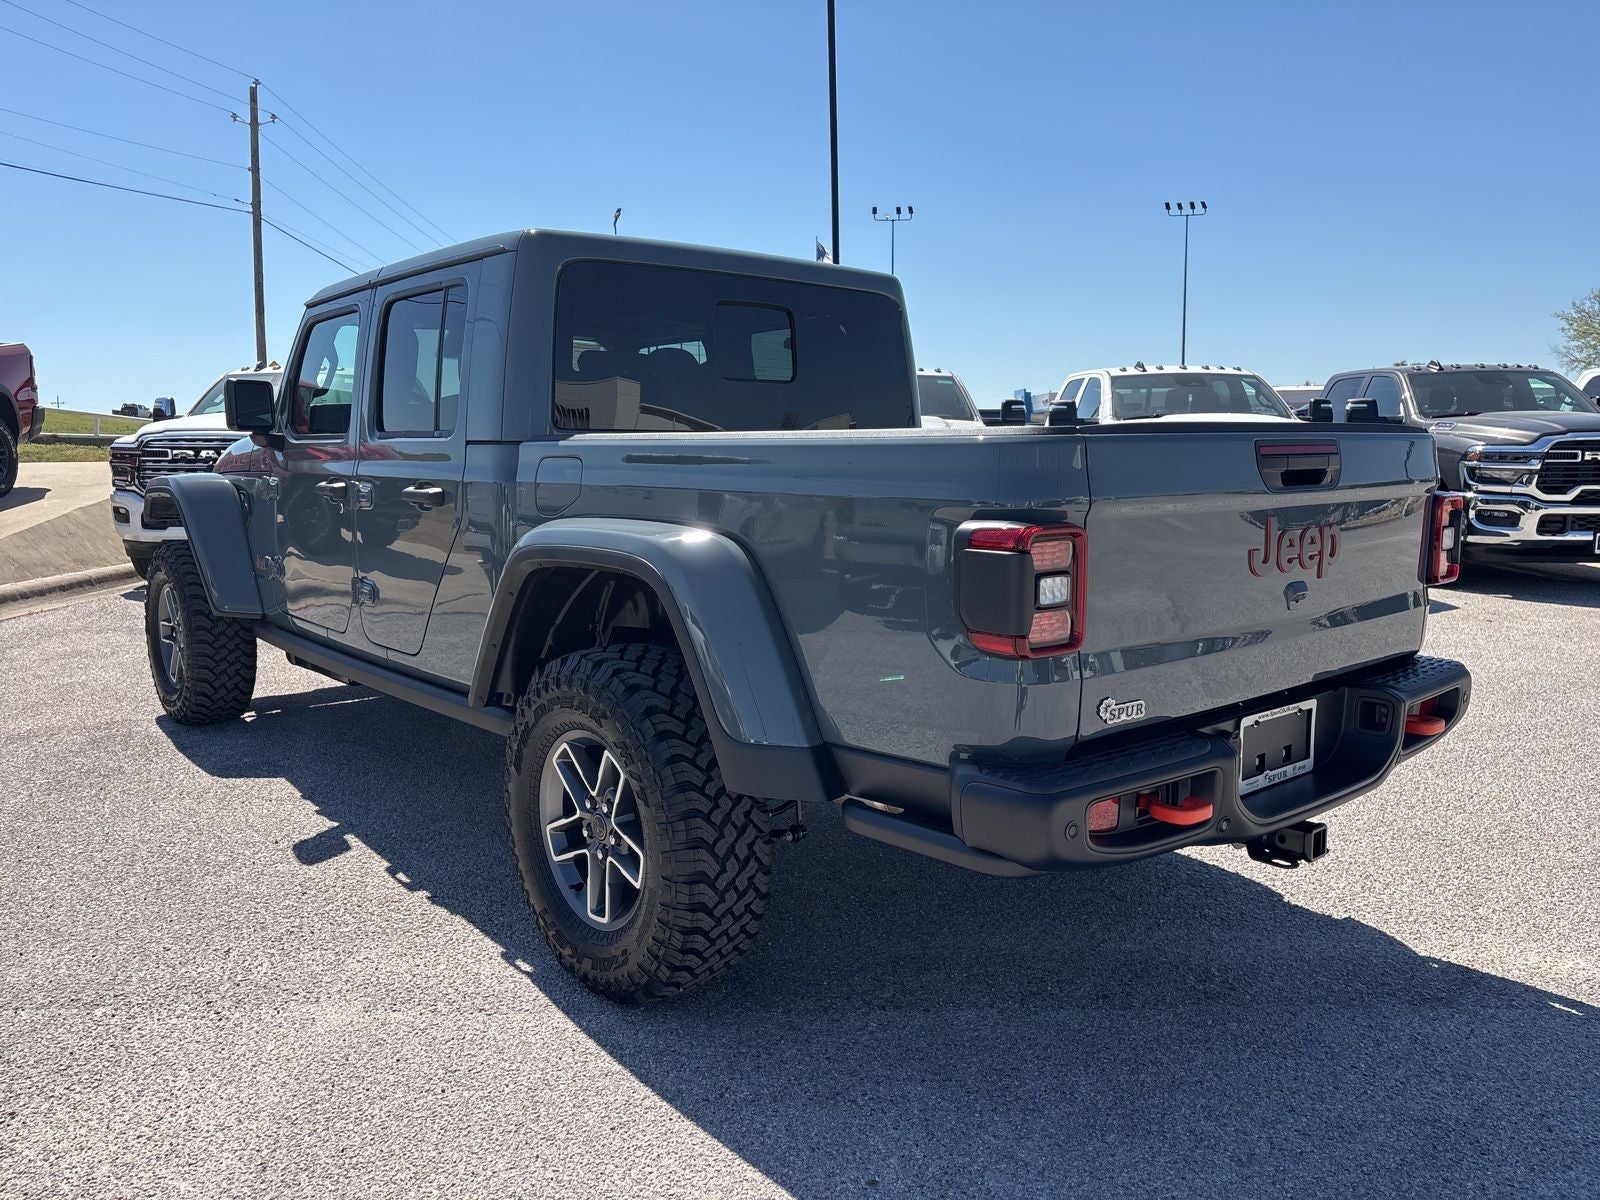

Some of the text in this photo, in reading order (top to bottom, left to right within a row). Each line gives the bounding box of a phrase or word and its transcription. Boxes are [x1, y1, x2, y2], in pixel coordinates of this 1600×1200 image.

[172, 449, 226, 459] RA
[1248, 514, 1340, 579] Jeep
[1110, 703, 1144, 721] SPUR
[1267, 770, 1288, 784] SPUR
